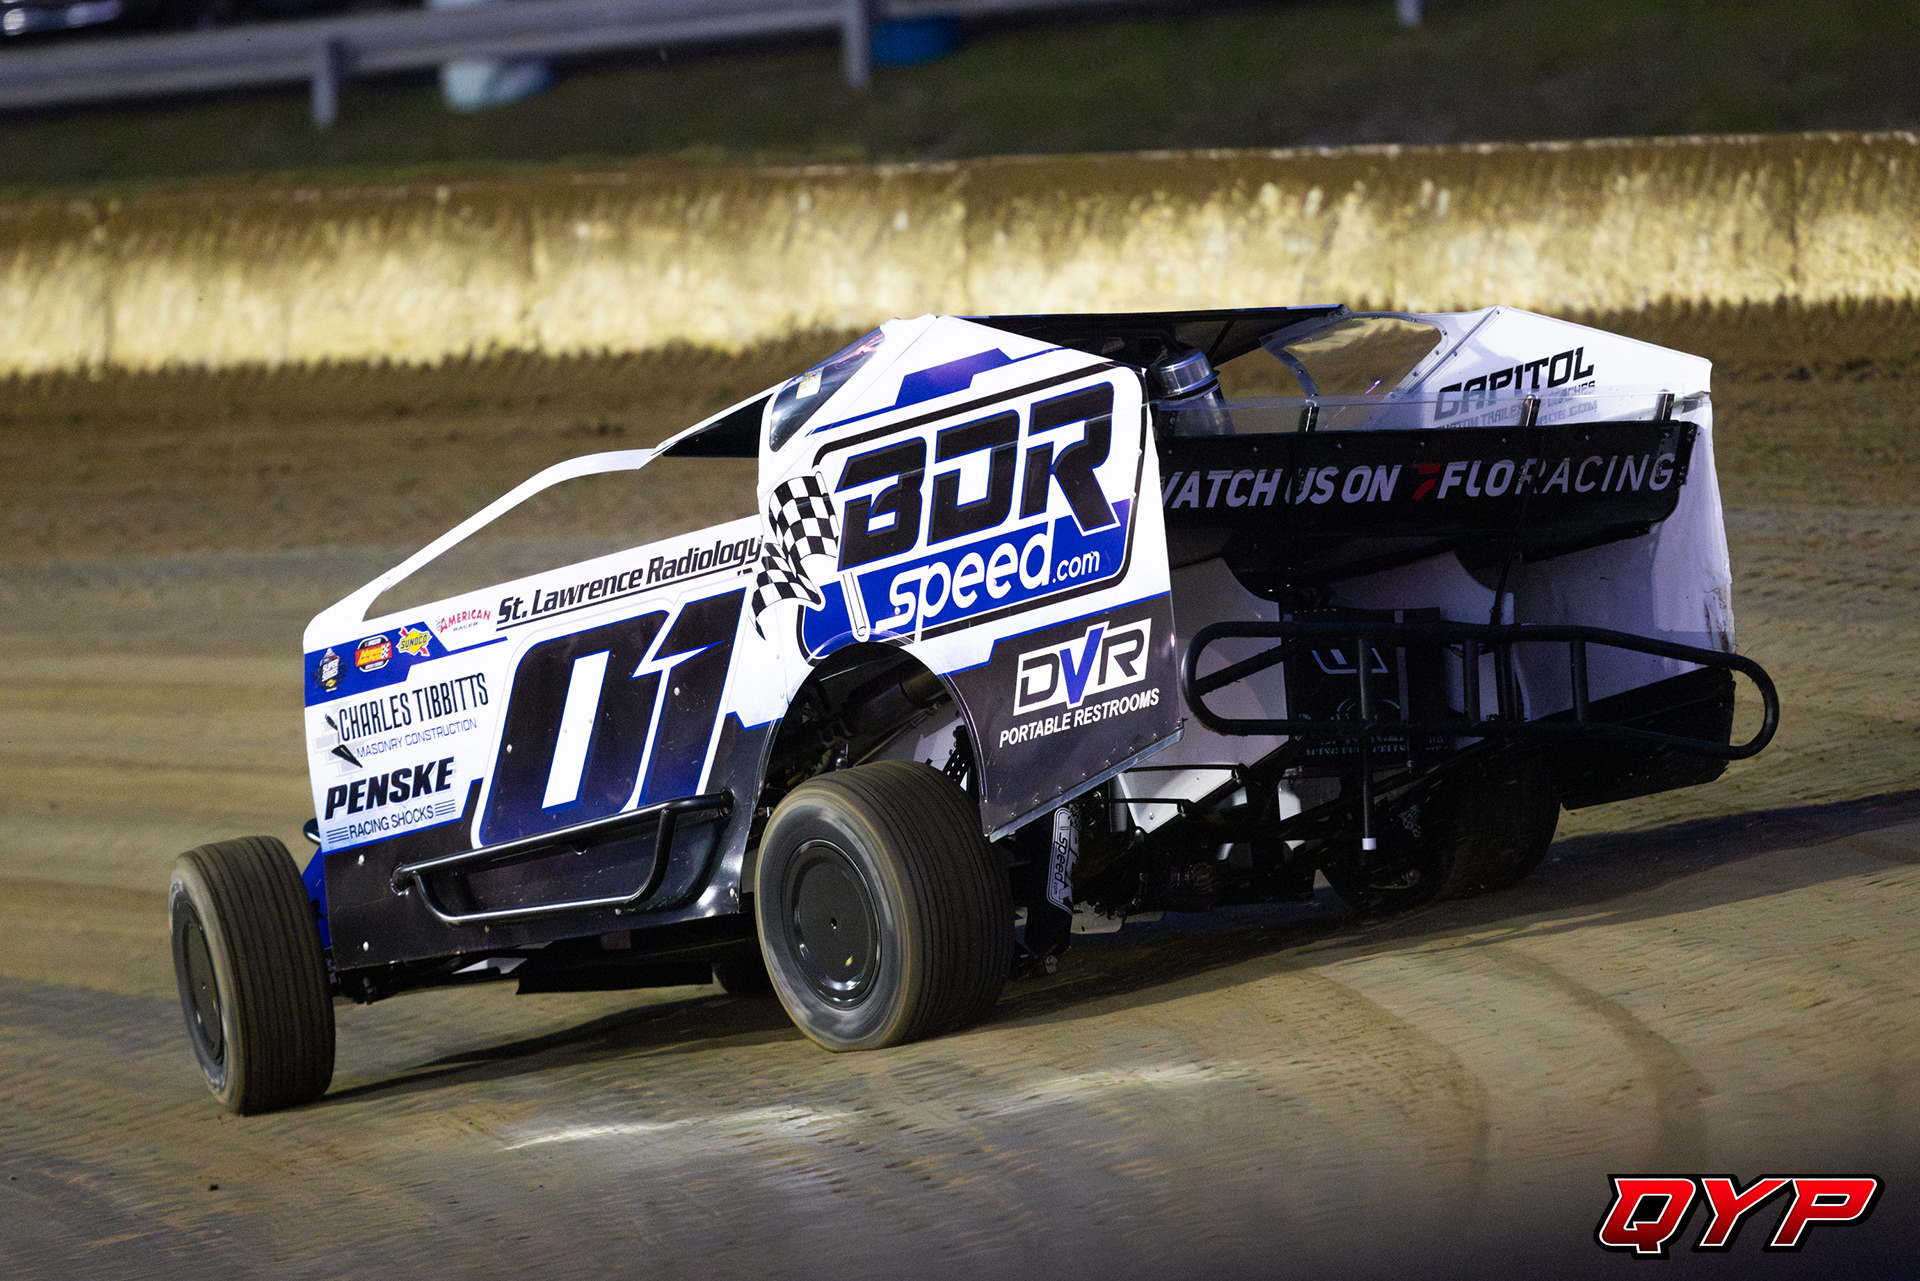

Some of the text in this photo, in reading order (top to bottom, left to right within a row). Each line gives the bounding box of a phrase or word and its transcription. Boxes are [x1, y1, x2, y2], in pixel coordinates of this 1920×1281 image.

[1434, 346, 1595, 420] CAPITOL
[836, 381, 1115, 570] BDR
[1341, 464, 1402, 503] ON
[497, 535, 764, 625] St. Lawrence Radiology
[400, 634, 428, 649] SUNOCO
[438, 609, 491, 634] AMERICAN
[453, 622, 479, 632] RACER
[1018, 627, 1145, 708] DVR
[338, 672, 489, 742] CHARLES TIBBITTS
[479, 587, 746, 847] 01
[999, 688, 1160, 748] PORTABLE RESTROOMS
[356, 718, 477, 758] MASONRY CONSTRUCTION
[325, 757, 455, 820] PENSKE
[349, 805, 434, 838] RACING SHOCKS
